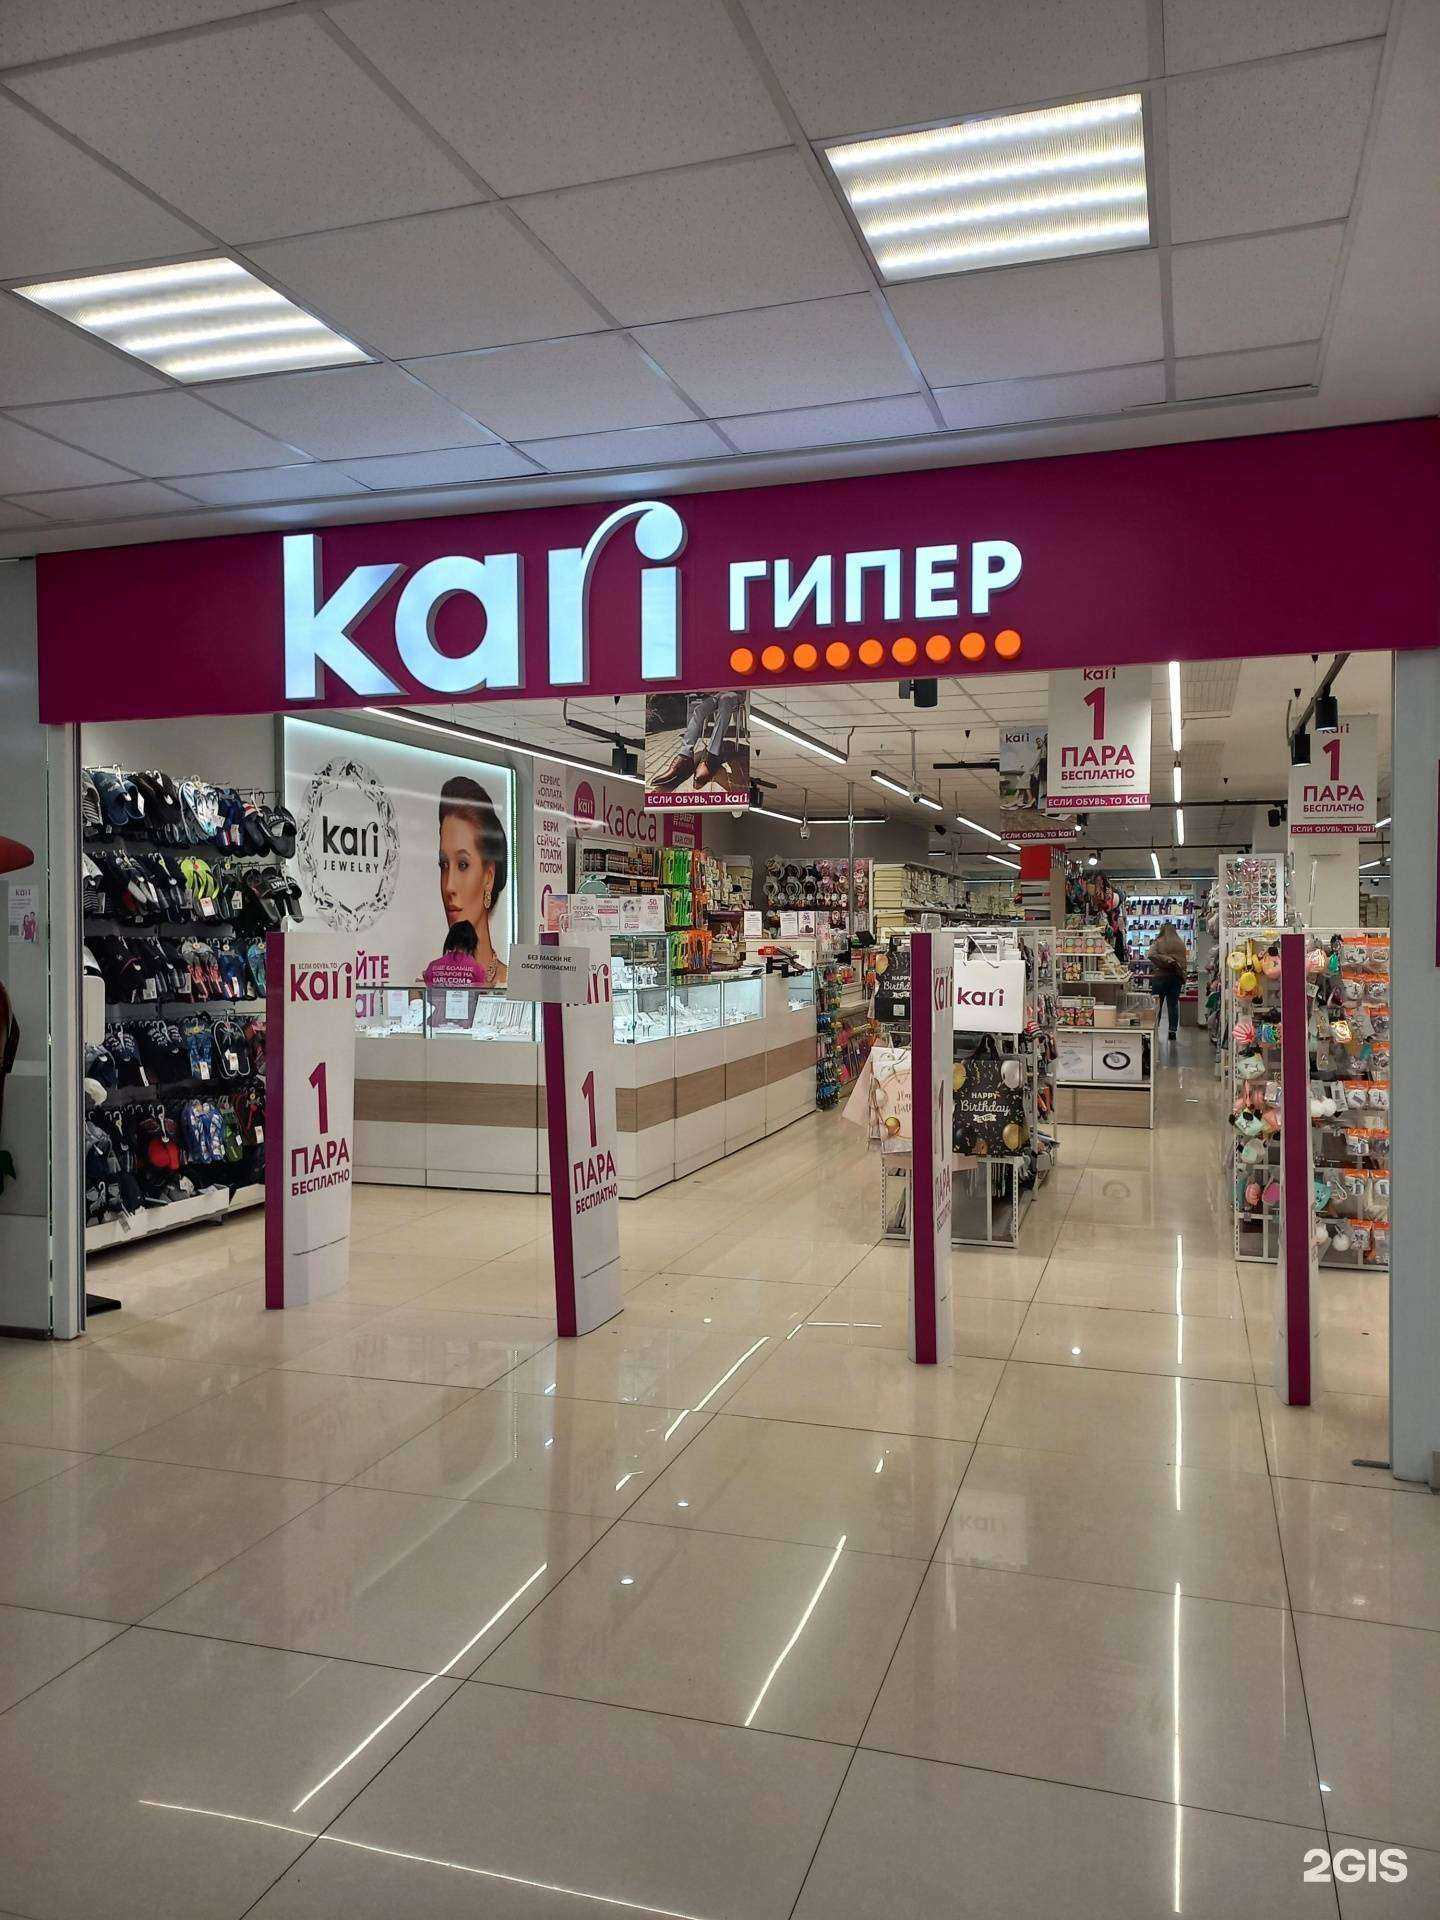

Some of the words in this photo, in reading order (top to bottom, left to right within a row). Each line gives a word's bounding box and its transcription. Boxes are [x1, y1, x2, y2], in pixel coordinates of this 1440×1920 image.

[729, 539, 1024, 633] ГИПЕР
[282, 501, 687, 699] kari
[1083, 666, 1116, 681] kari
[1083, 687, 1105, 741] 1
[1005, 733, 1030, 743] kari
[1061, 744, 1135, 768] ПАРА
[1322, 739, 1341, 781] 1
[1061, 768, 1135, 781] БЕСПЛАТНО
[647, 795, 672, 804] ЕСЛИ
[675, 795, 708, 804] ОБУВЬ,
[709, 794, 722, 803] ТО
[725, 793, 748, 803] kari
[1048, 798, 1073, 807] ЕСЛИ
[1075, 796, 1108, 806] ОБУВЬ,
[1125, 794, 1148, 804] kari
[1303, 784, 1365, 802] ПАРА
[1303, 803, 1365, 813] БЕСПЛАТНО
[543, 820, 559, 832] БЕРИ
[322, 815, 379, 858] kari
[537, 833, 561, 848] СЕЙЧАС
[541, 848, 562, 861] ПЛАТИ
[323, 860, 379, 874] JEWELRY
[540, 862, 562, 874] ПОТОМ
[355, 950, 389, 980] ЙТЕ
[540, 954, 561, 962] МАСКИ
[290, 962, 352, 1002] kari
[957, 987, 1005, 1007] kari
[308, 1061, 329, 1135] 1
[971, 1091, 997, 1099] HAPPY
[581, 1070, 598, 1148] 1
[960, 1099, 1010, 1117] Birthday
[291, 1137, 350, 1178] ПАРА
[573, 1150, 617, 1195] ПАРА
[291, 1168, 350, 1197] БЕСПЛАТНО
[575, 1182, 618, 1215] БЕСПЛАТНО
